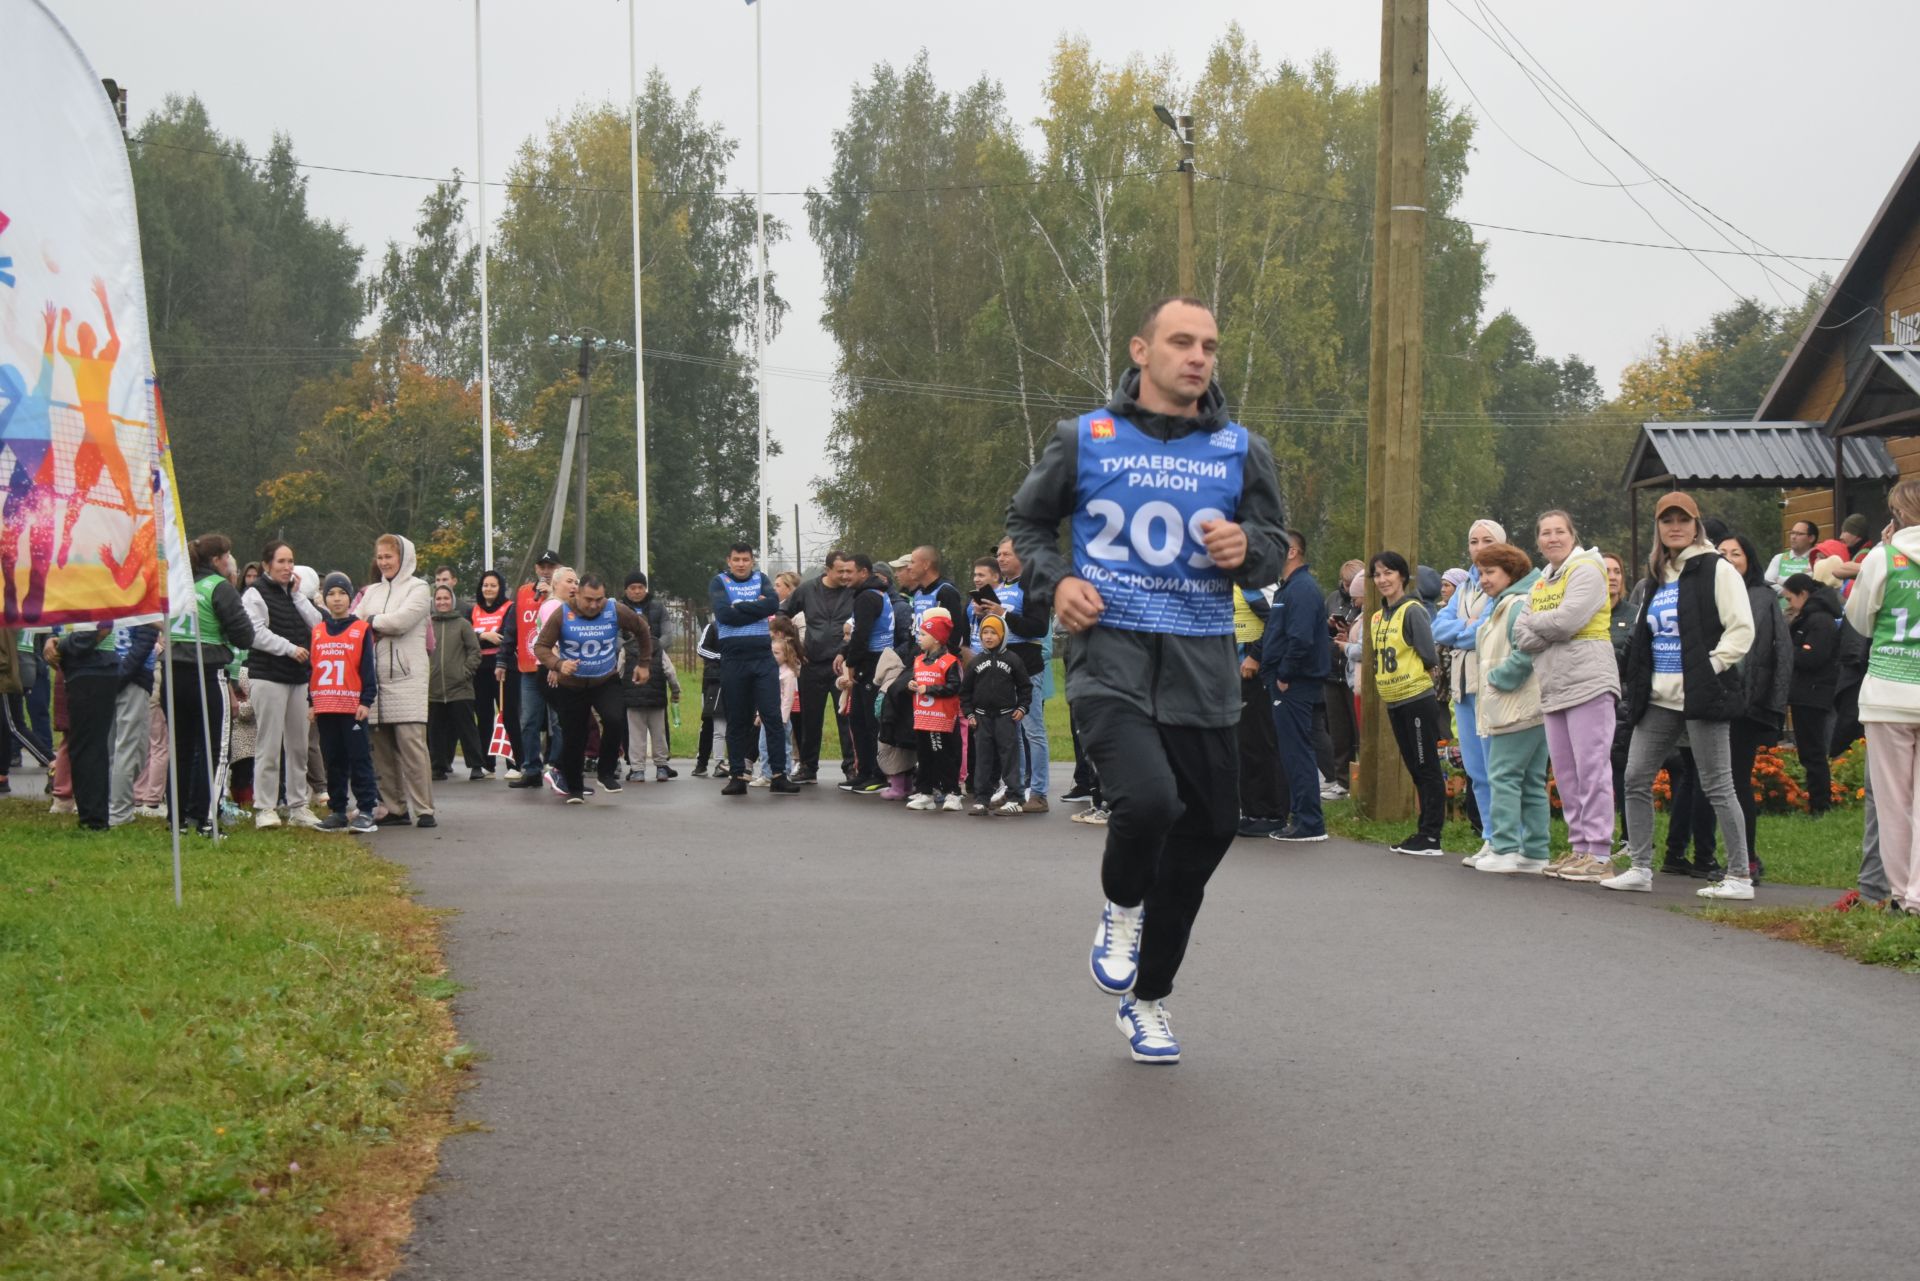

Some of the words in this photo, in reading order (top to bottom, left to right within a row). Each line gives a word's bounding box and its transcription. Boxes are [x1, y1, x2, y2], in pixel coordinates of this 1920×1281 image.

[1100, 455, 1227, 479] ТУКАЕВСКИЙ
[1128, 471, 1198, 492] РАЙОН
[570, 623, 613, 631] ТУКАЕВСКИЙ
[564, 637, 615, 657] 203
[317, 660, 345, 686] 21
